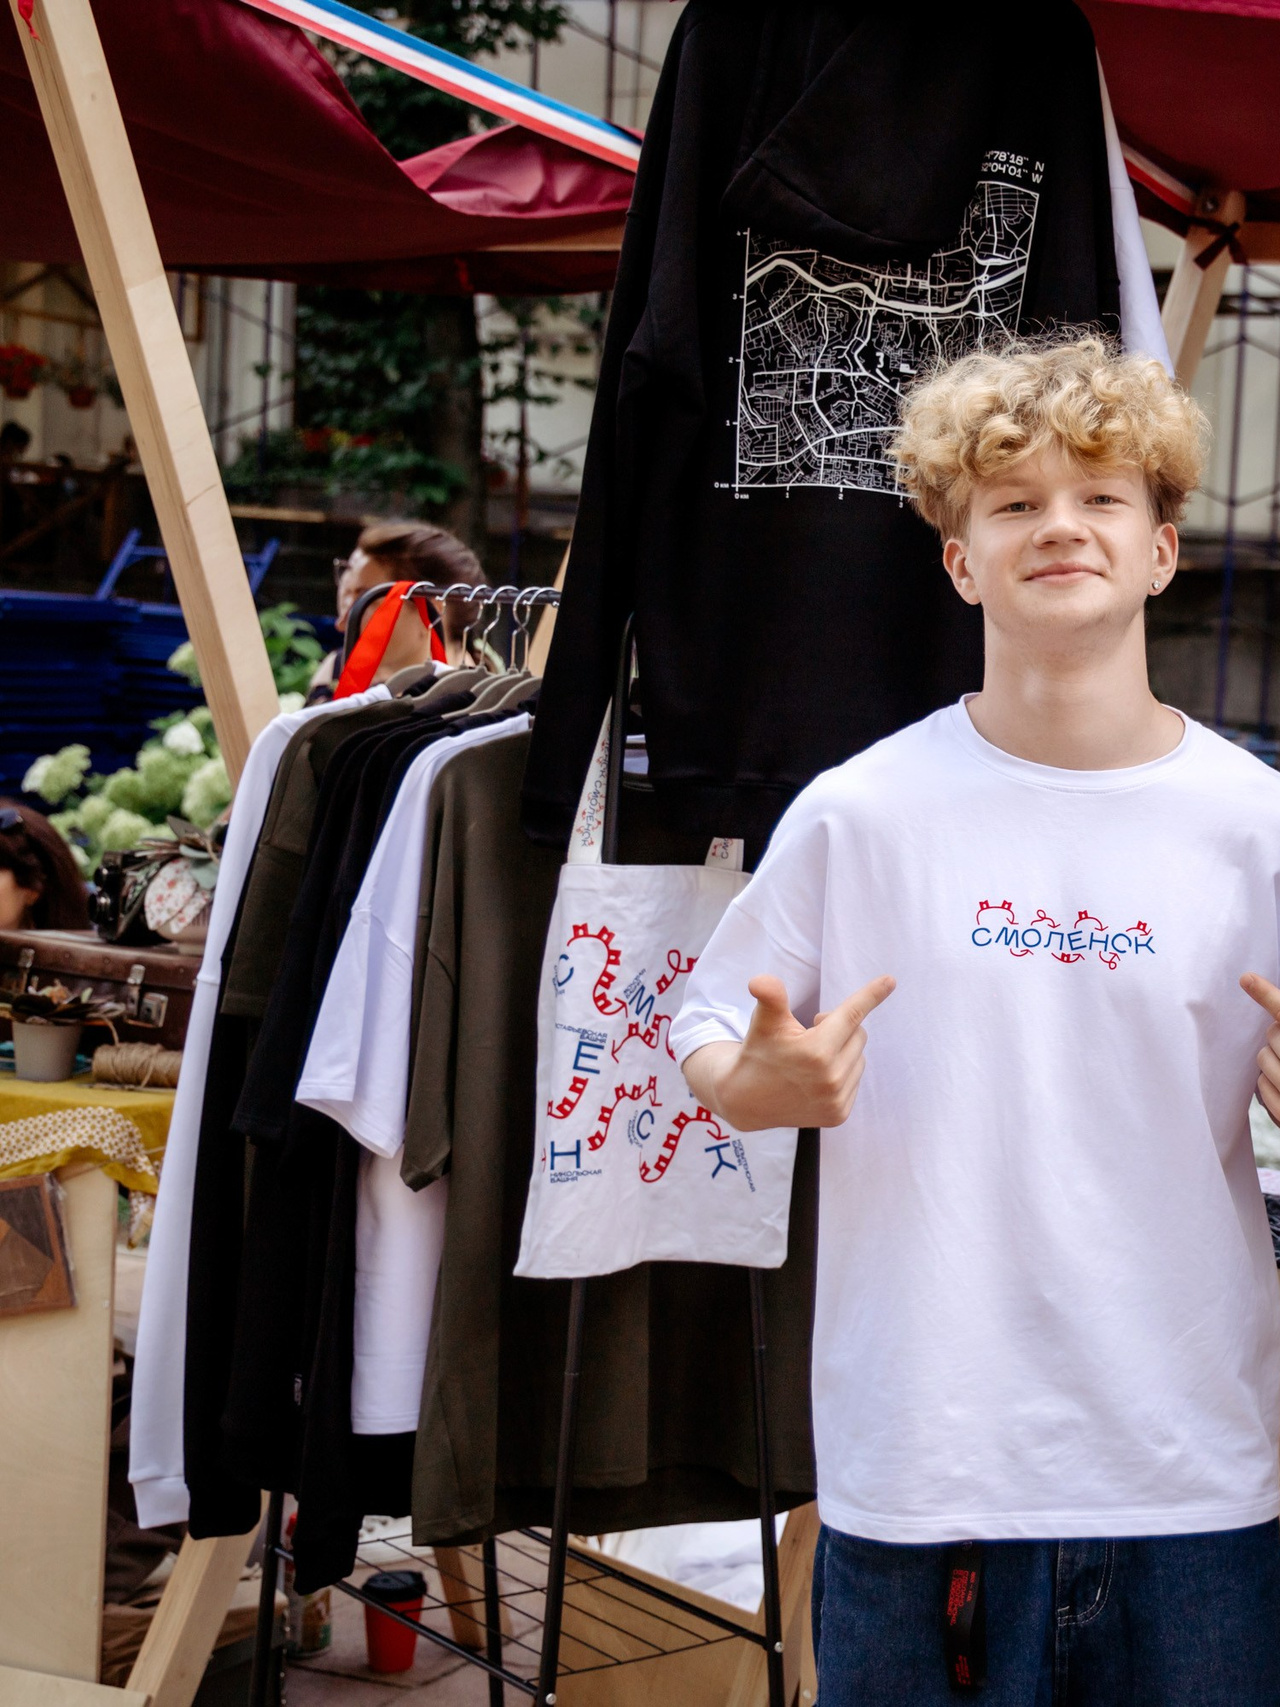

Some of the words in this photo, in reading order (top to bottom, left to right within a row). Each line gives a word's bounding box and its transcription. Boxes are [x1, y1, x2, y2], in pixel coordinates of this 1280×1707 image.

[1031, 172, 1043, 184] W
[1034, 161, 1045, 172] N
[581, 780, 603, 847] СМОЛЕНСК
[971, 926, 1156, 955] СМОЛЕНСК
[628, 984, 656, 1025] М
[572, 1040, 605, 1075] Е
[636, 1109, 655, 1141] С
[550, 1139, 581, 1171] Н
[704, 1142, 738, 1180] К
